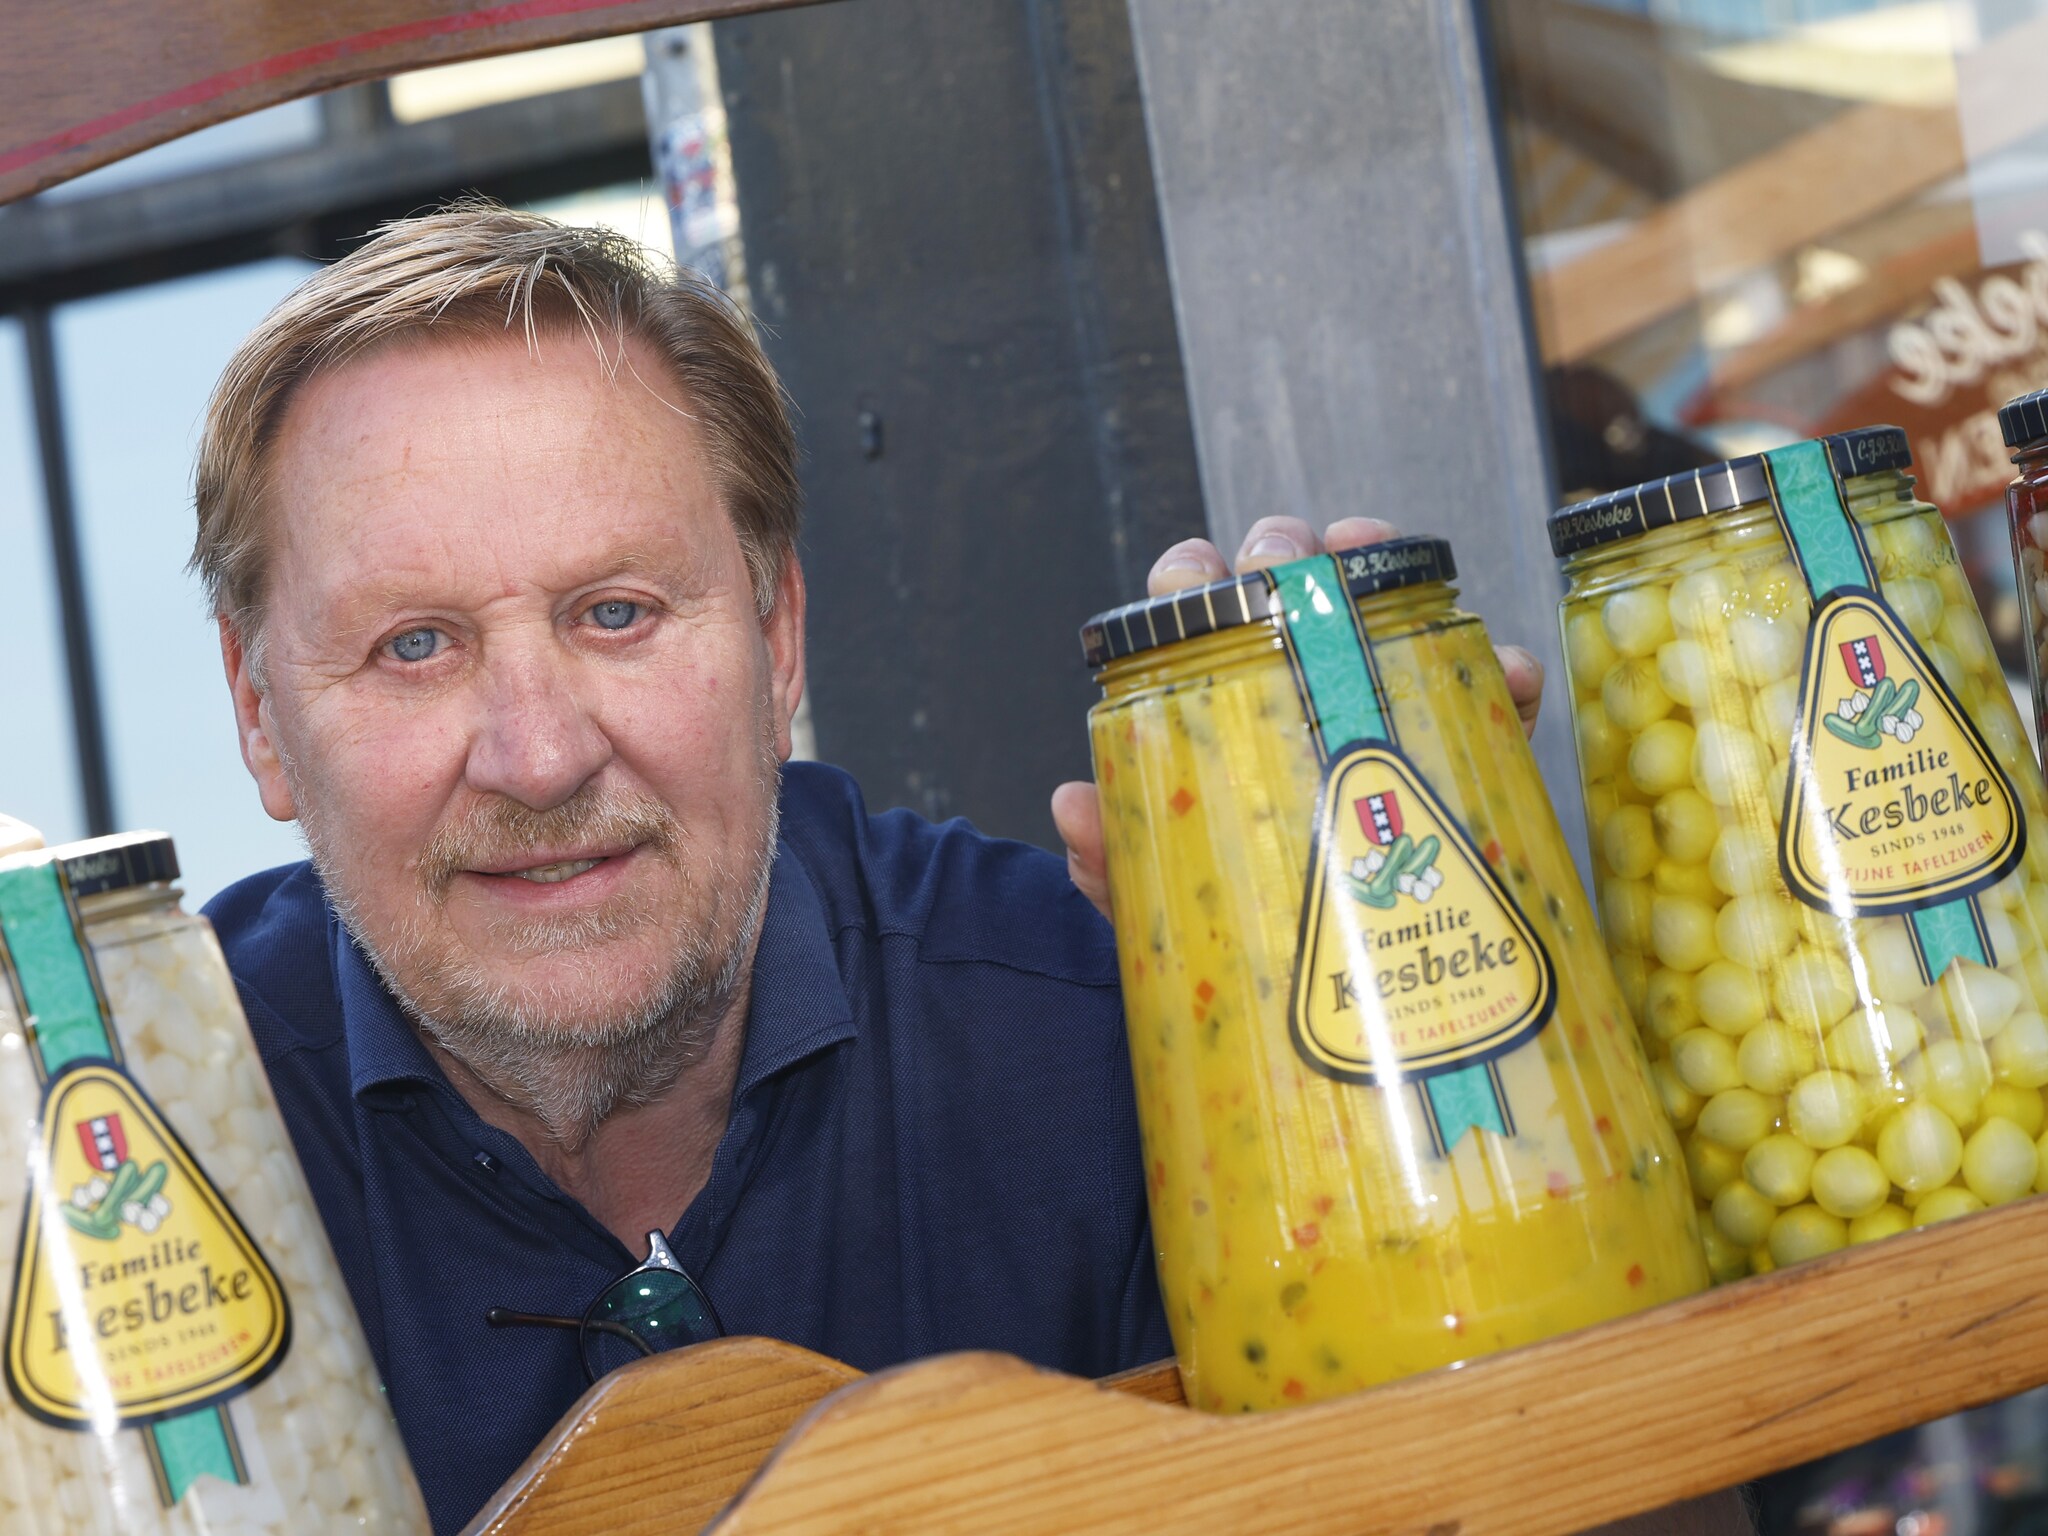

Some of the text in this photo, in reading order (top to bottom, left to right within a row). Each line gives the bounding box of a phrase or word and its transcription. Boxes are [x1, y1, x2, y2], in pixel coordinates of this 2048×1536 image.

[1844, 748, 1949, 793] Familie
[1824, 772, 1992, 844] Kesbeke
[1870, 823, 1965, 858] SINDS 1948
[1903, 829, 1994, 876] TAFELZUREN
[1418, 992, 1518, 1041] TAFELZUREN
[1451, 985, 1485, 1004] 1948
[80, 1238, 201, 1289] Familie
